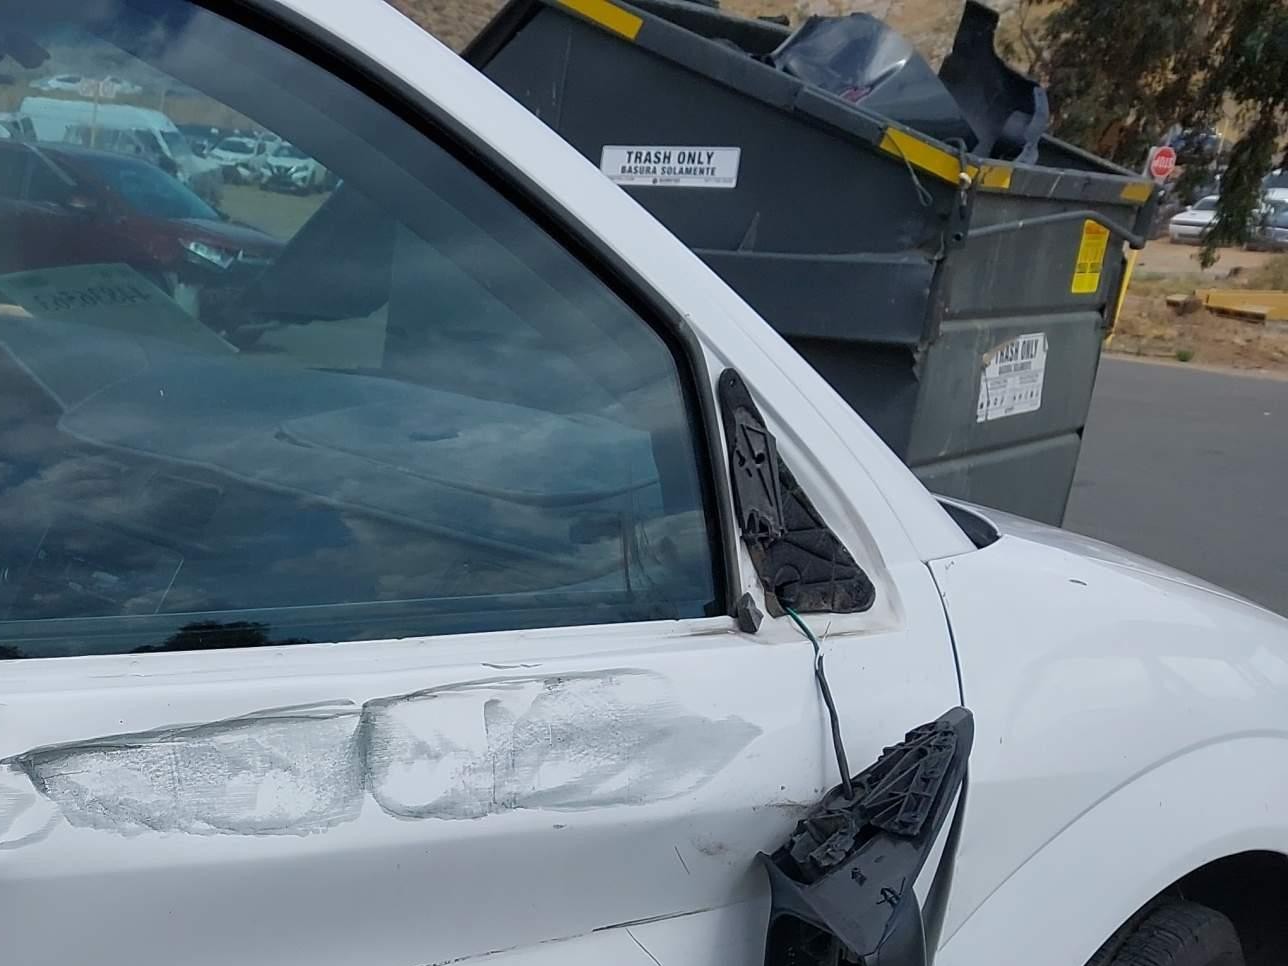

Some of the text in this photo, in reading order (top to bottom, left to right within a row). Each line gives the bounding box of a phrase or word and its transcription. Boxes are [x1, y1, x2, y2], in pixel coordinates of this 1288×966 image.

[626, 151, 714, 165] TRASH ONLY
[620, 165, 716, 176] BASURA SOLAMENTE
